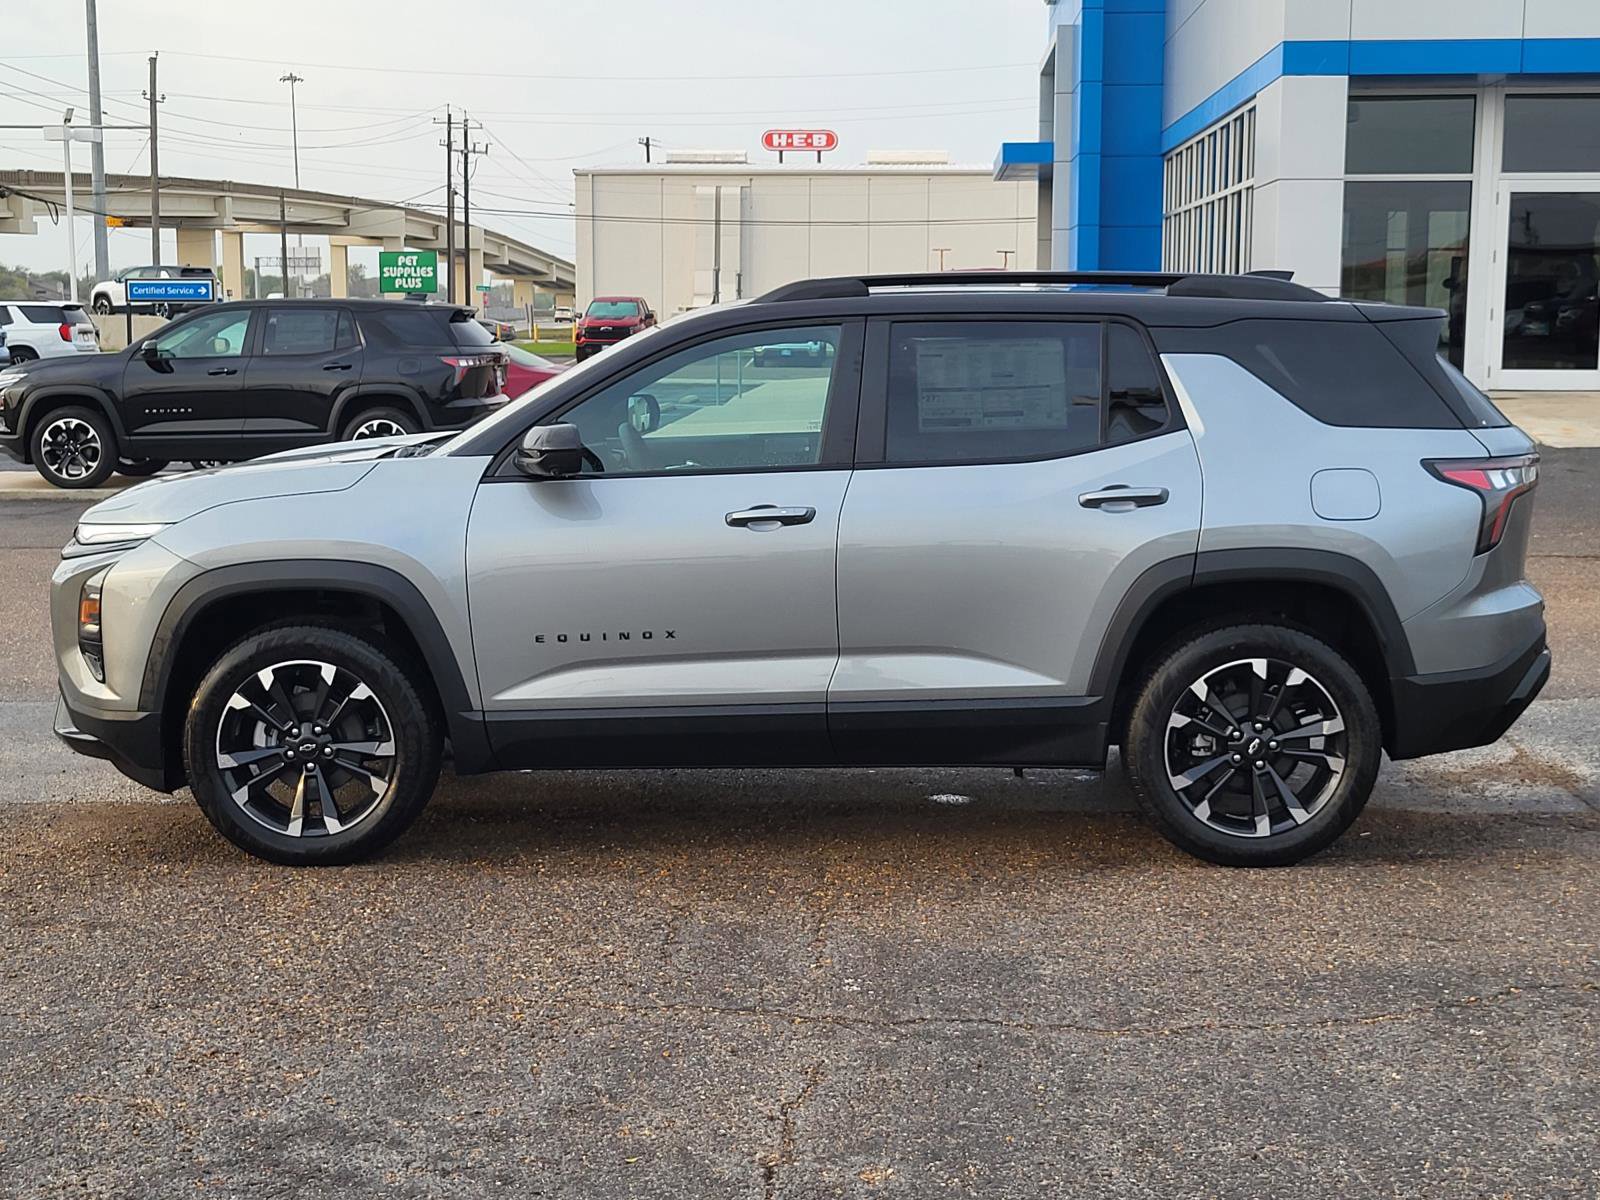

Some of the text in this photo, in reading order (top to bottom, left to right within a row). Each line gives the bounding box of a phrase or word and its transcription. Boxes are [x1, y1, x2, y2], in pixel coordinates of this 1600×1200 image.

[398, 256, 418, 266] PET
[383, 266, 434, 277] SUPPLIES
[395, 278, 422, 288] PLUS
[132, 286, 195, 295] Certified Service
[535, 630, 676, 644] EQUINOX
